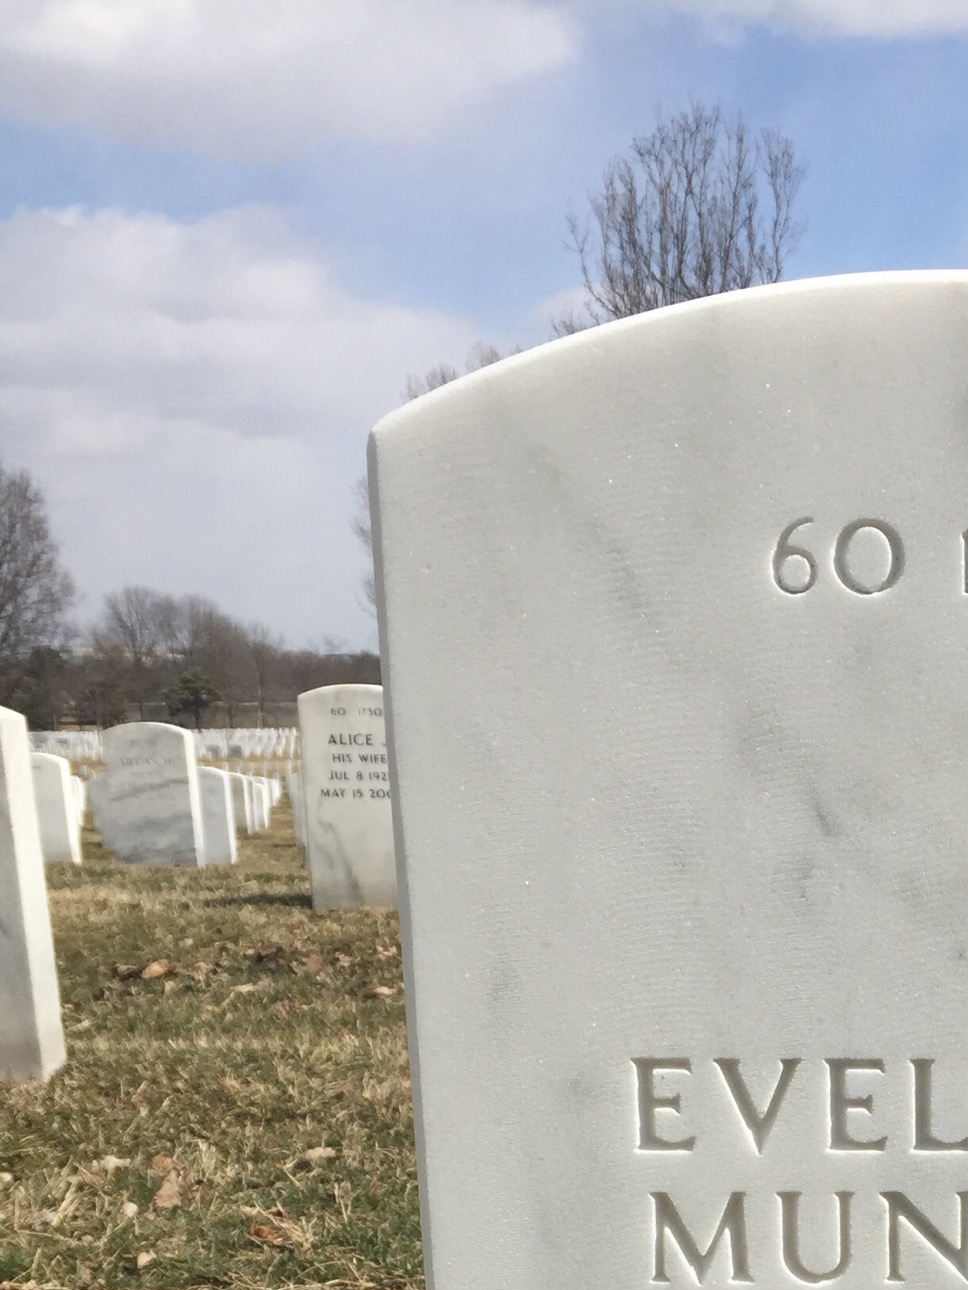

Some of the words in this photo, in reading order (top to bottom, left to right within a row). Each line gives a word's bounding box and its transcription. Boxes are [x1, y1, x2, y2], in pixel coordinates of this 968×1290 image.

[773, 516, 906, 596] 60
[330, 707, 346, 716] 60
[327, 733, 374, 746] ALICE
[332, 753, 352, 763] HIS
[358, 753, 388, 764] WIFE
[329, 770, 350, 781] JUL
[356, 770, 363, 781] 8
[368, 771, 388, 782] 192
[320, 788, 346, 798] MAY
[352, 788, 363, 798] 15
